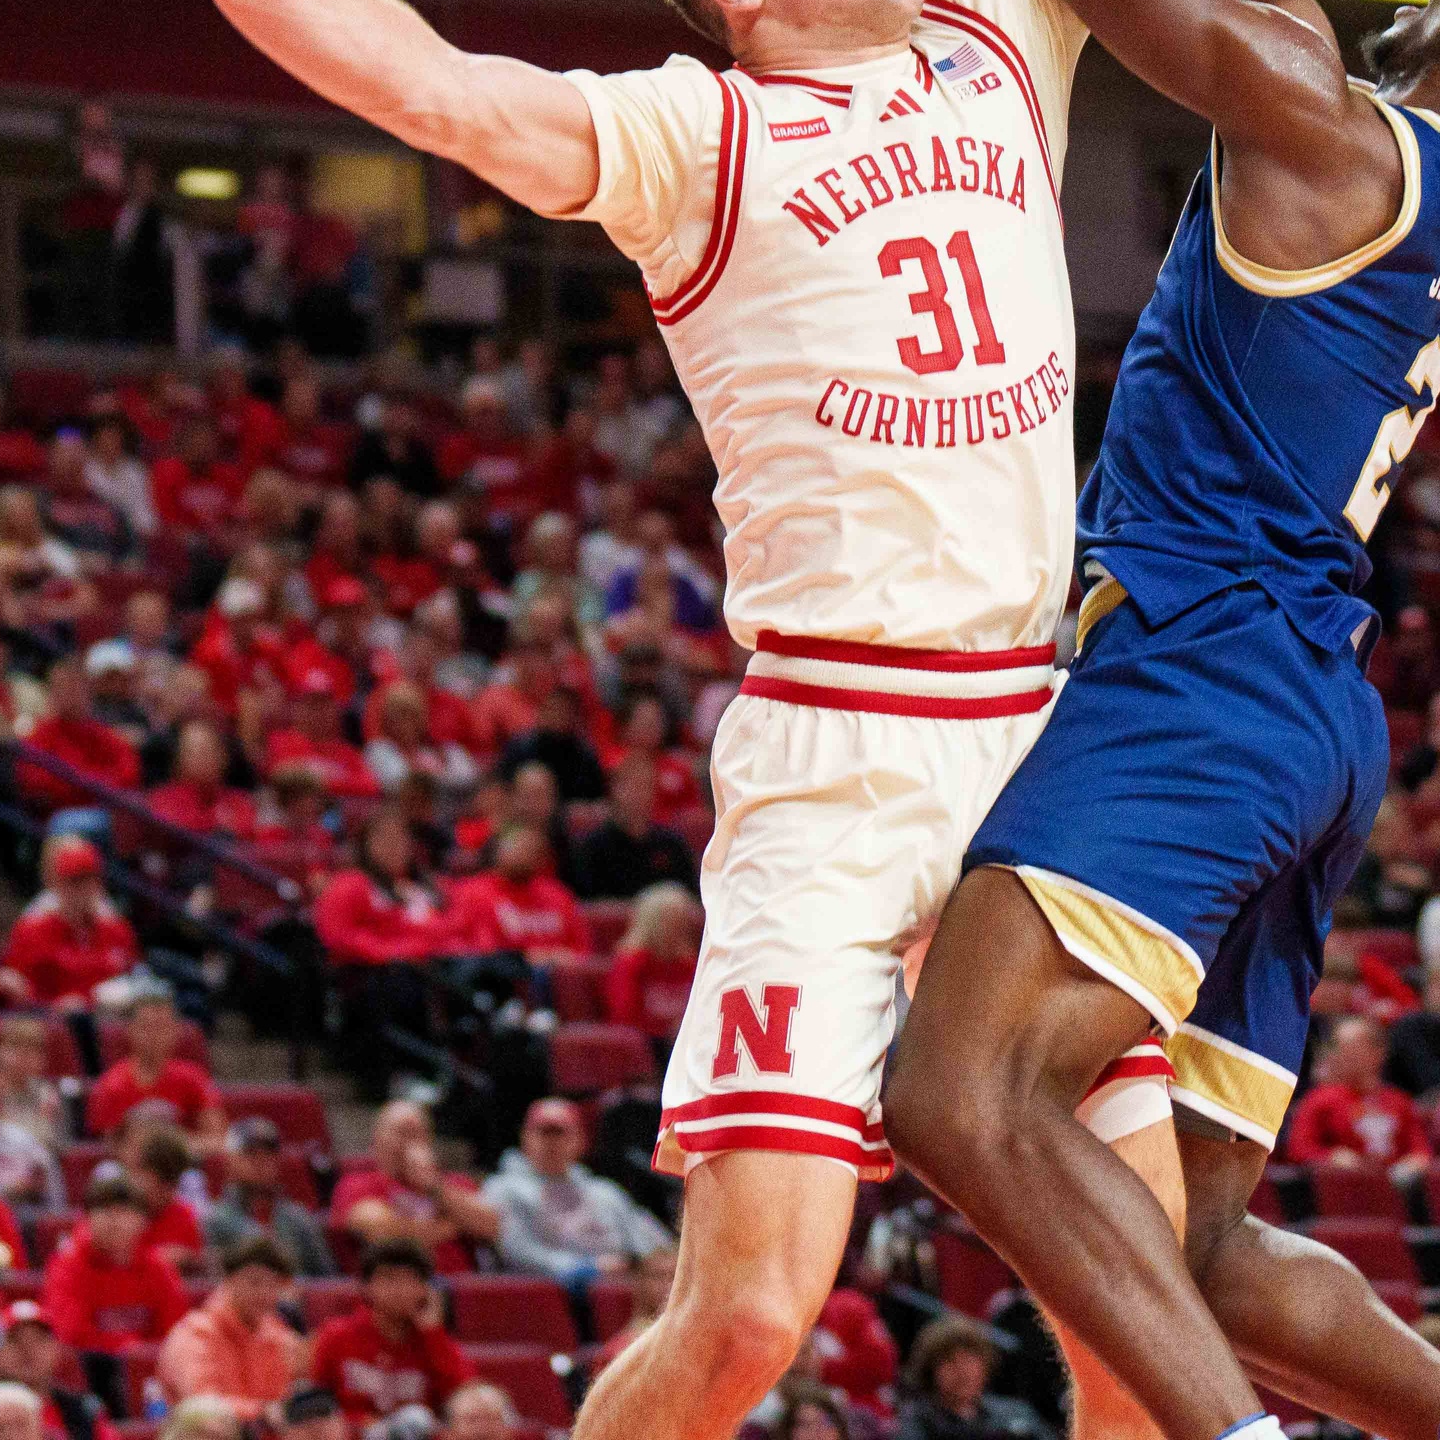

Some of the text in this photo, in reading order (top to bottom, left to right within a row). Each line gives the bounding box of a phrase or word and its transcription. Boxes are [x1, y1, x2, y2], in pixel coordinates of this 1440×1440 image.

[772, 121, 828, 139] GRADUATE
[782, 135, 1028, 247] NEBRASKA
[877, 230, 1006, 375] 31
[815, 350, 1071, 448] CORNHUSKERS
[711, 981, 803, 1084] N
